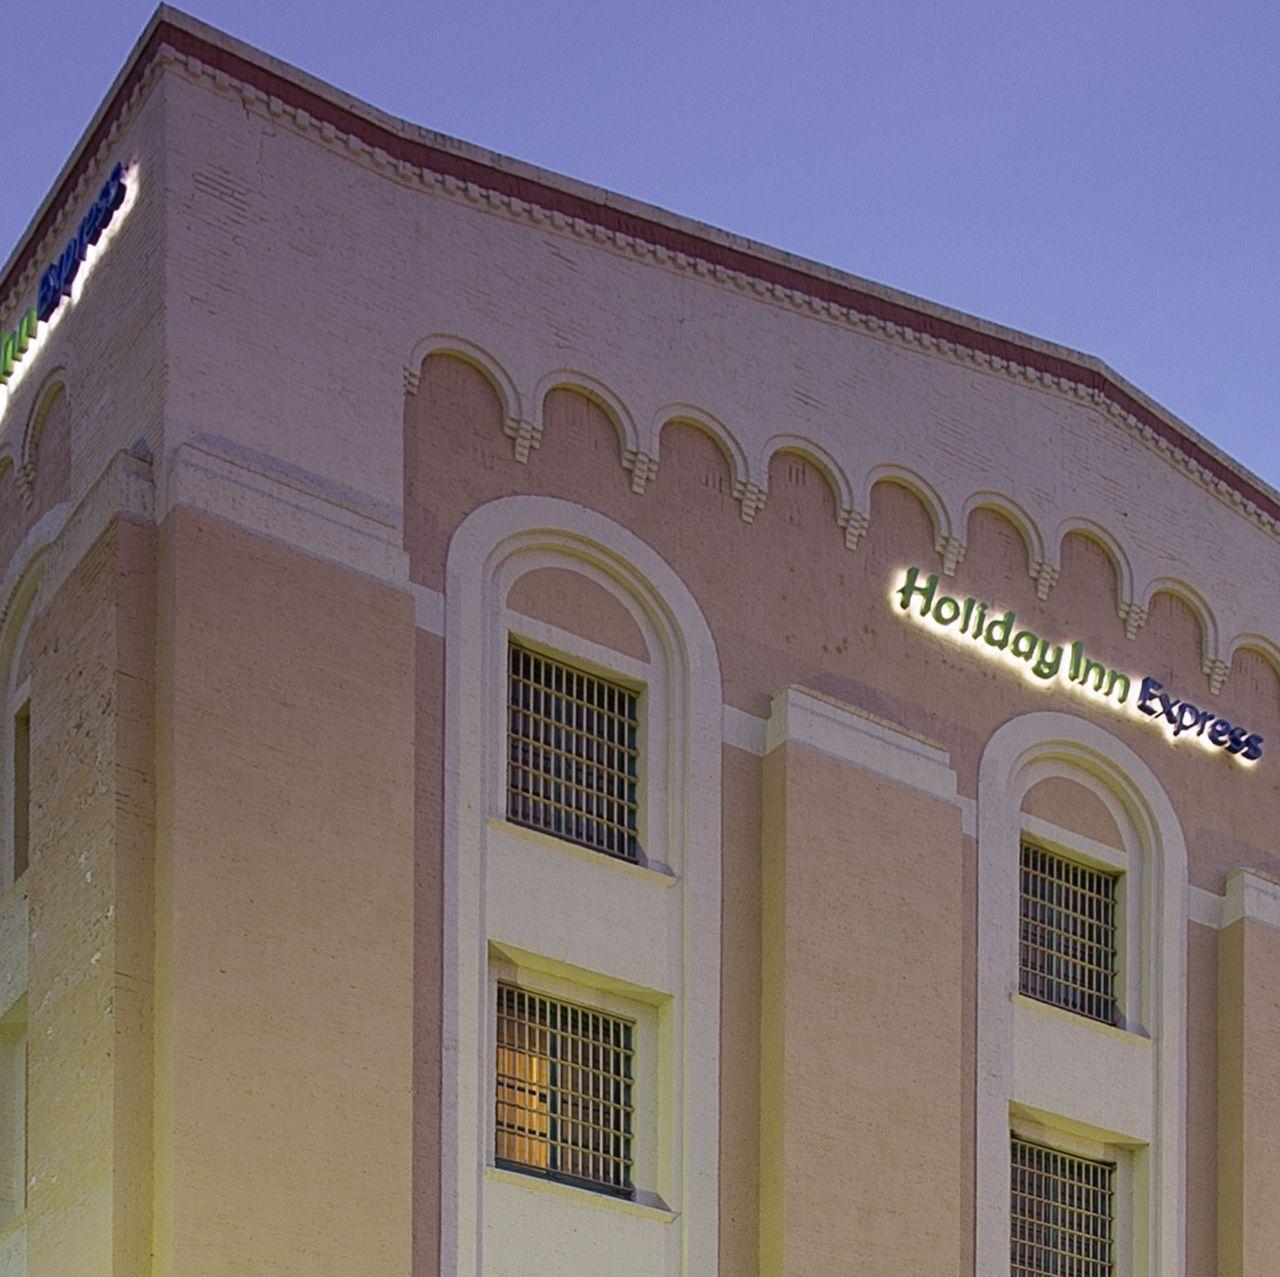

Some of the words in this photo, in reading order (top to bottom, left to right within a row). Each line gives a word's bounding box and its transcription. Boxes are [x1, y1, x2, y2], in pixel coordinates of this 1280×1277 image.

[897, 566, 1063, 679] Holiday
[1069, 640, 1131, 703] Inn
[1138, 676, 1264, 761] Express
